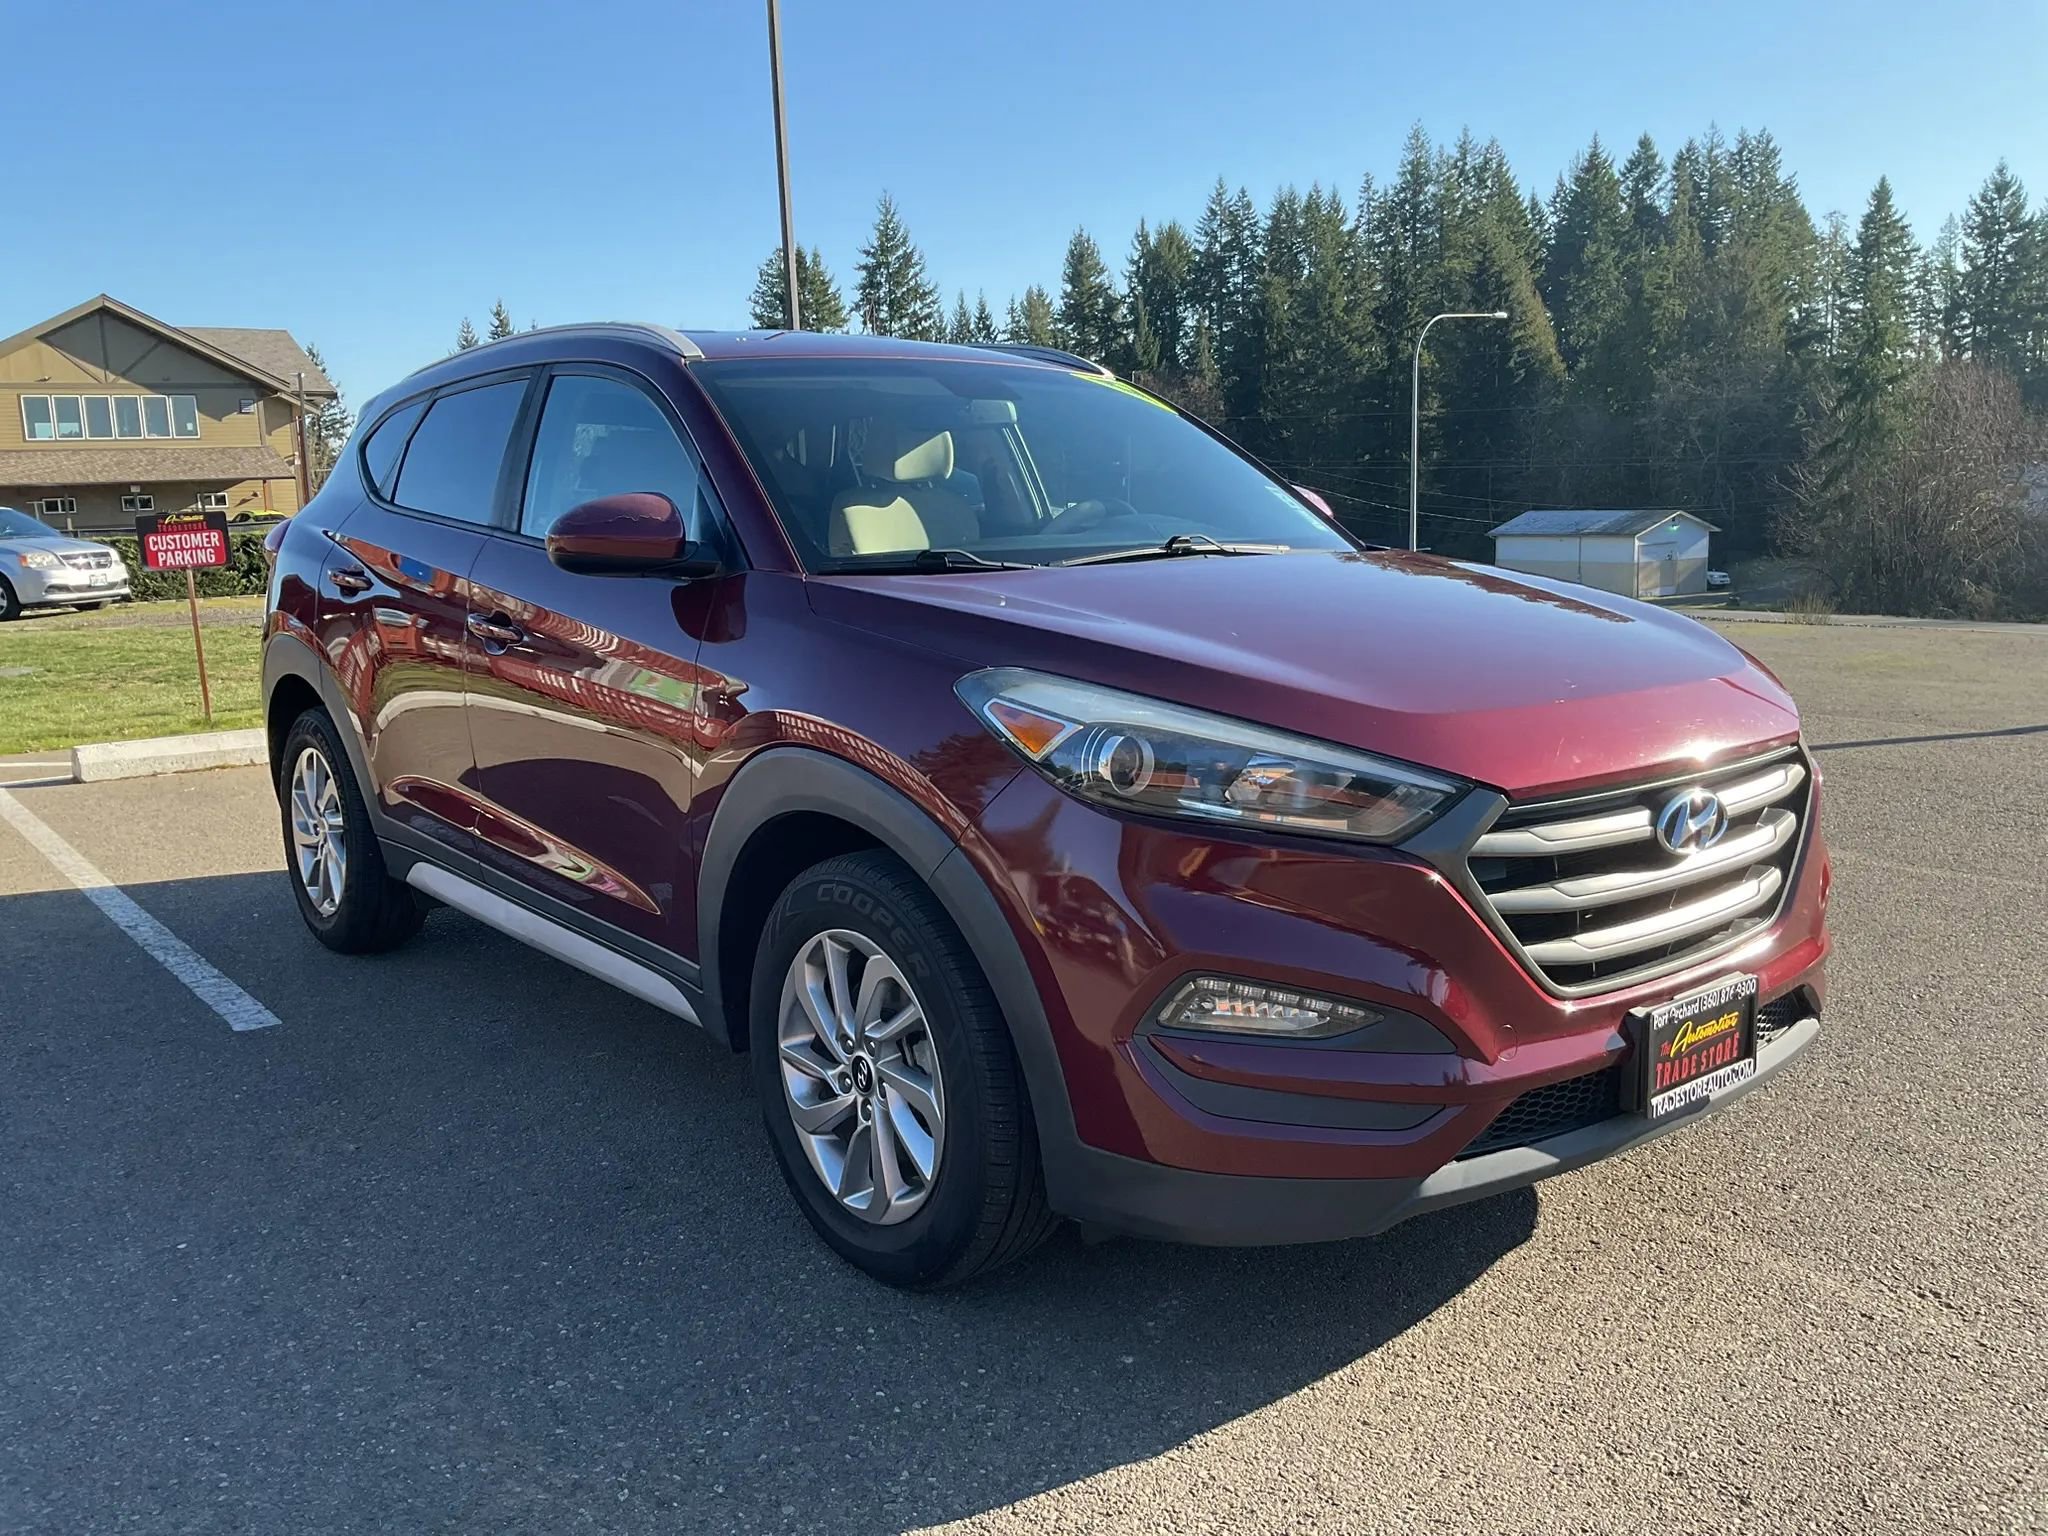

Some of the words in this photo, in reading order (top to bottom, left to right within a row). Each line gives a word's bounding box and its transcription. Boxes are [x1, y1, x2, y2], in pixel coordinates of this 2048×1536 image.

[149, 532, 220, 551] CUSTOMER
[158, 548, 216, 567] PARKING
[817, 883, 930, 977] COOPER
[1653, 1012, 1669, 1030] Port
[1700, 990, 1720, 1012] (360)
[1656, 1053, 1698, 1089] TRADE
[1700, 1032, 1740, 1071] STORE
[1651, 1060, 1755, 1119] TRADESTOREAUTO.COM
